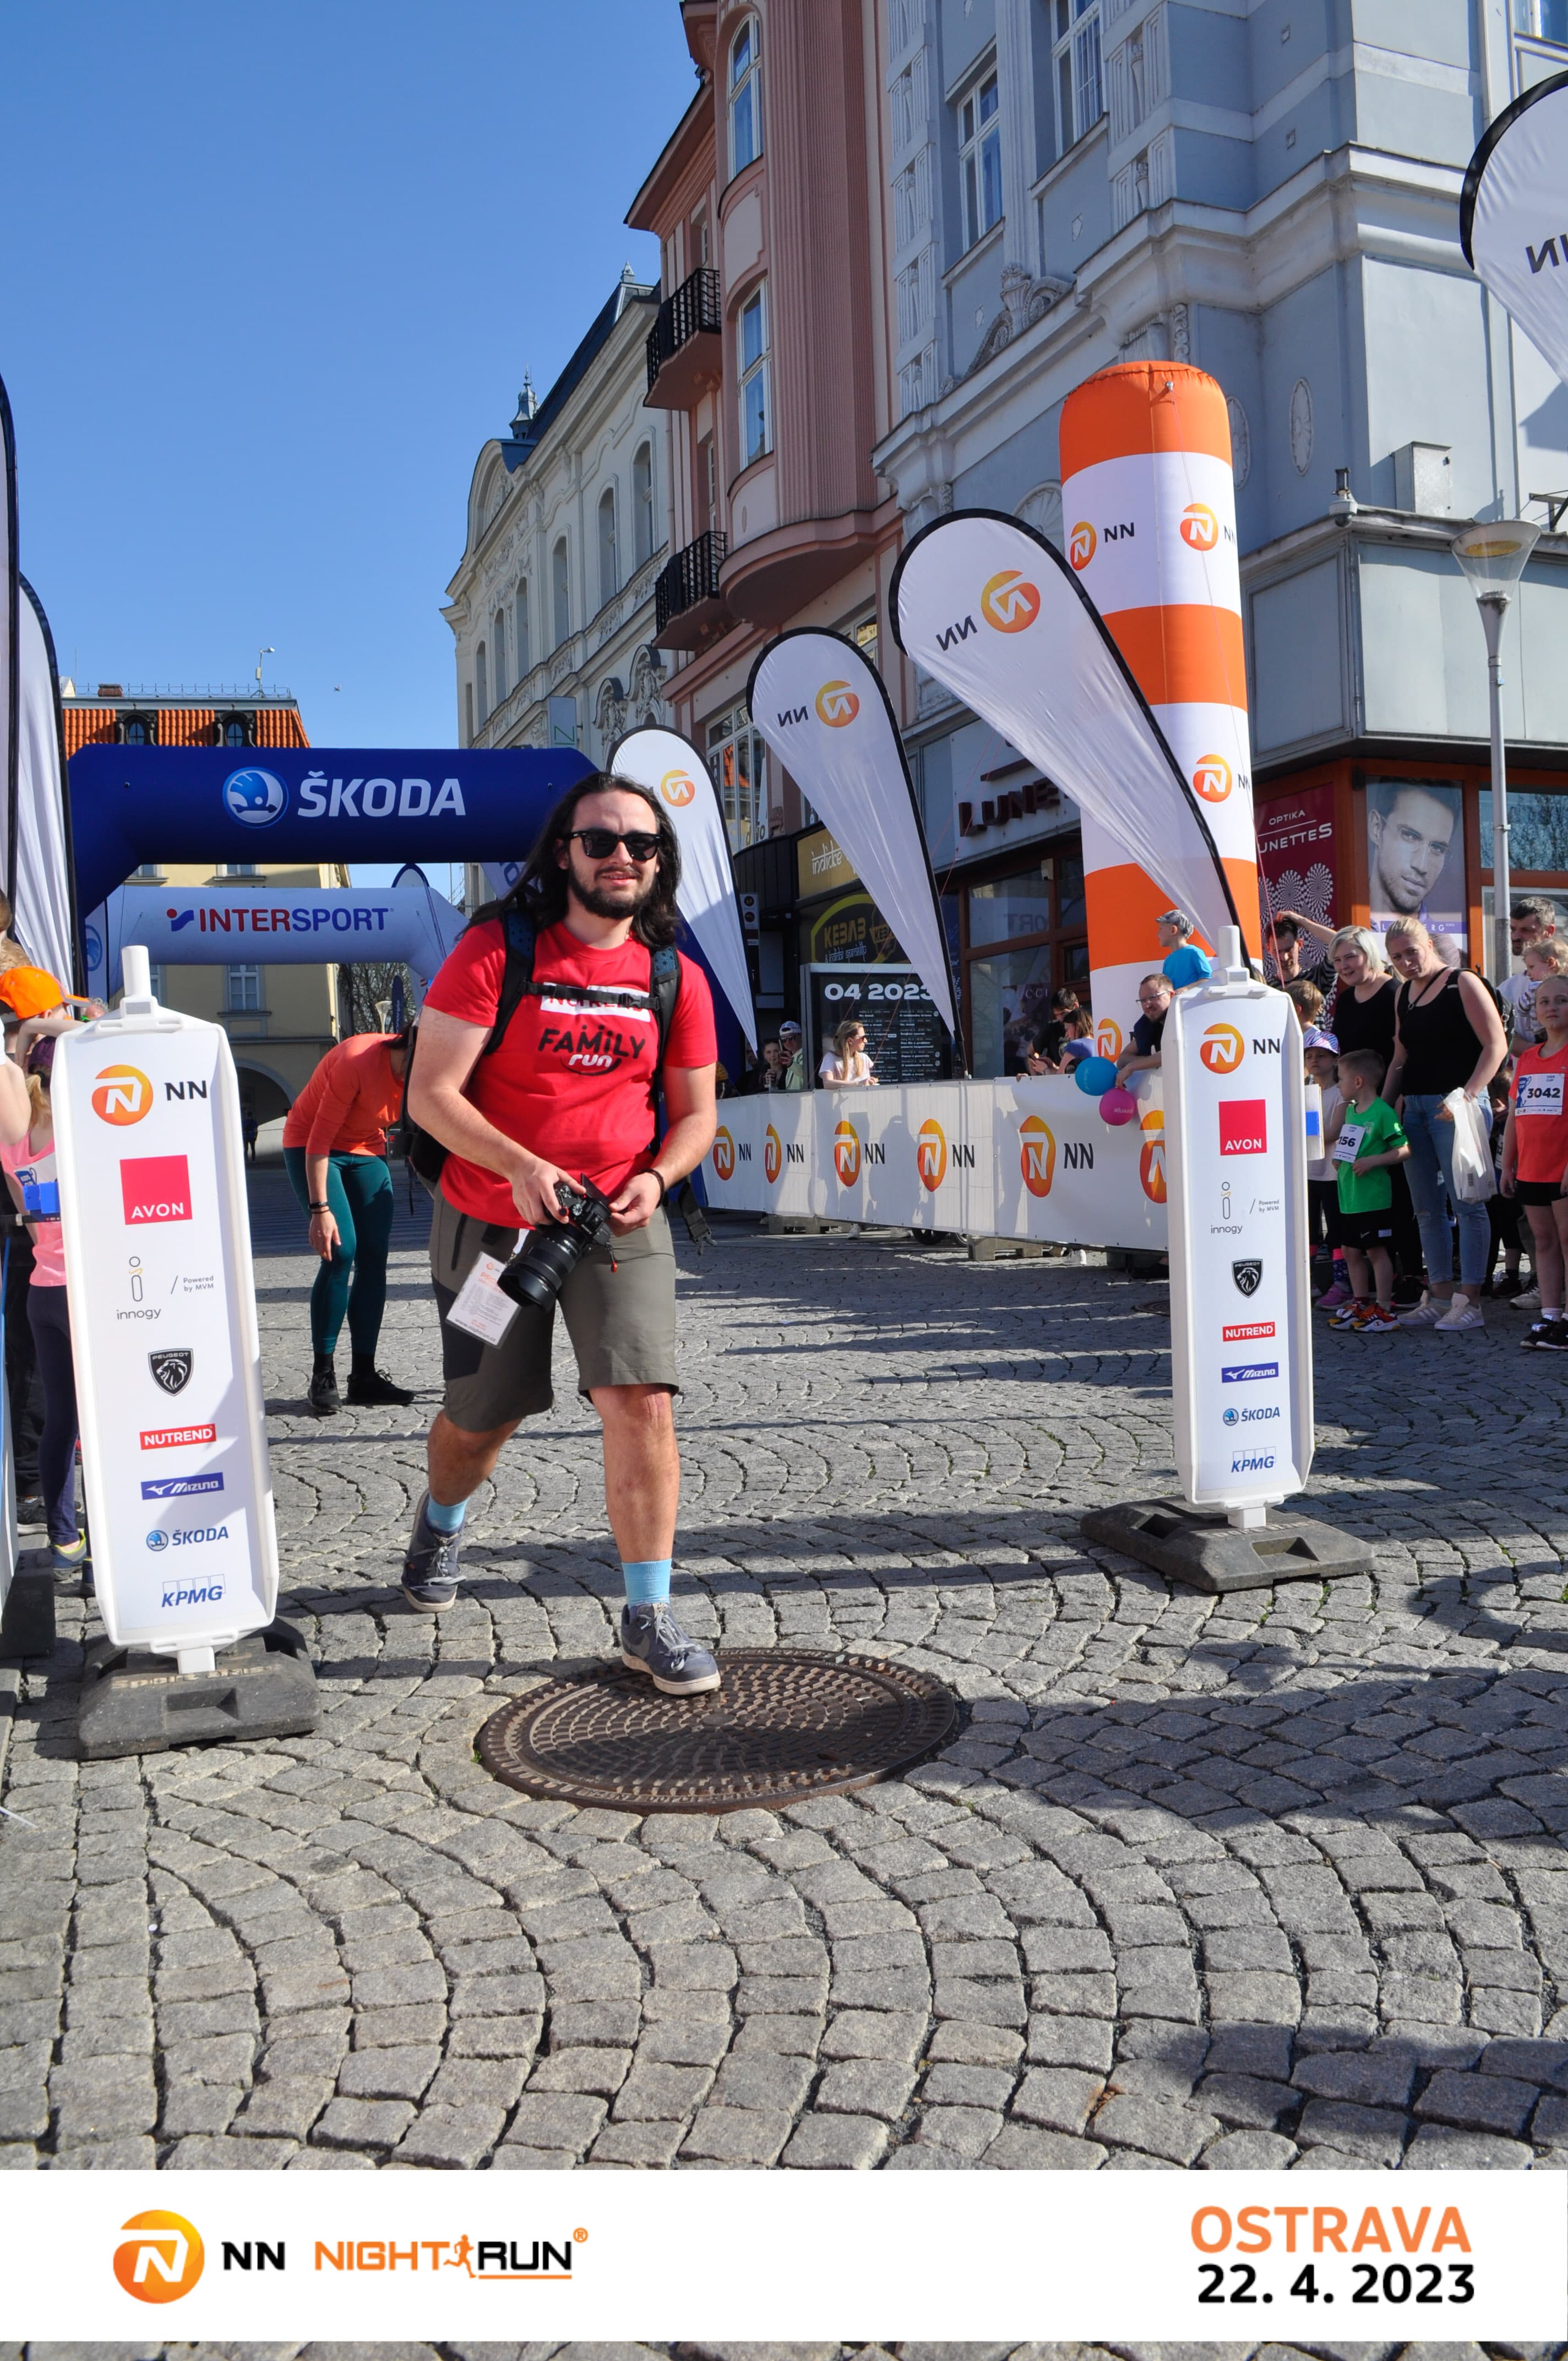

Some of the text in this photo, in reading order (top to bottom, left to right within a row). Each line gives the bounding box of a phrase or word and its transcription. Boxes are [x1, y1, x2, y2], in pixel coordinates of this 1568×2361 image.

[1103, 523, 1136, 543] NN
[297, 771, 466, 818] ŠKODA
[1268, 809, 1305, 825] OPTIKA
[199, 907, 389, 932] INTERSPORT
[825, 983, 861, 1000] 04
[1253, 1038, 1280, 1054] NN
[568, 1054, 613, 1067] run
[164, 1080, 208, 1101] NN
[1527, 1087, 1560, 1098] 3042
[738, 1143, 752, 1161] NN
[1225, 1138, 1262, 1151] AVON
[787, 1144, 804, 1163] NN
[865, 1143, 885, 1165] NN
[952, 1145, 975, 1168] NN
[1064, 1143, 1094, 1169] NN
[131, 1203, 184, 1219] AVON
[1211, 1225, 1243, 1234] innogy
[183, 1275, 214, 1283] Powered
[116, 1307, 161, 1320] innogy
[1226, 1325, 1273, 1339] NUTREND
[152, 1352, 189, 1360] PEUGEOT
[1241, 1406, 1280, 1422] ŠKODA
[144, 1428, 213, 1446] NUTREND
[1231, 1455, 1275, 1473] KPMG
[172, 1526, 229, 1546] ŠKODA
[161, 1586, 223, 1607] KPMG
